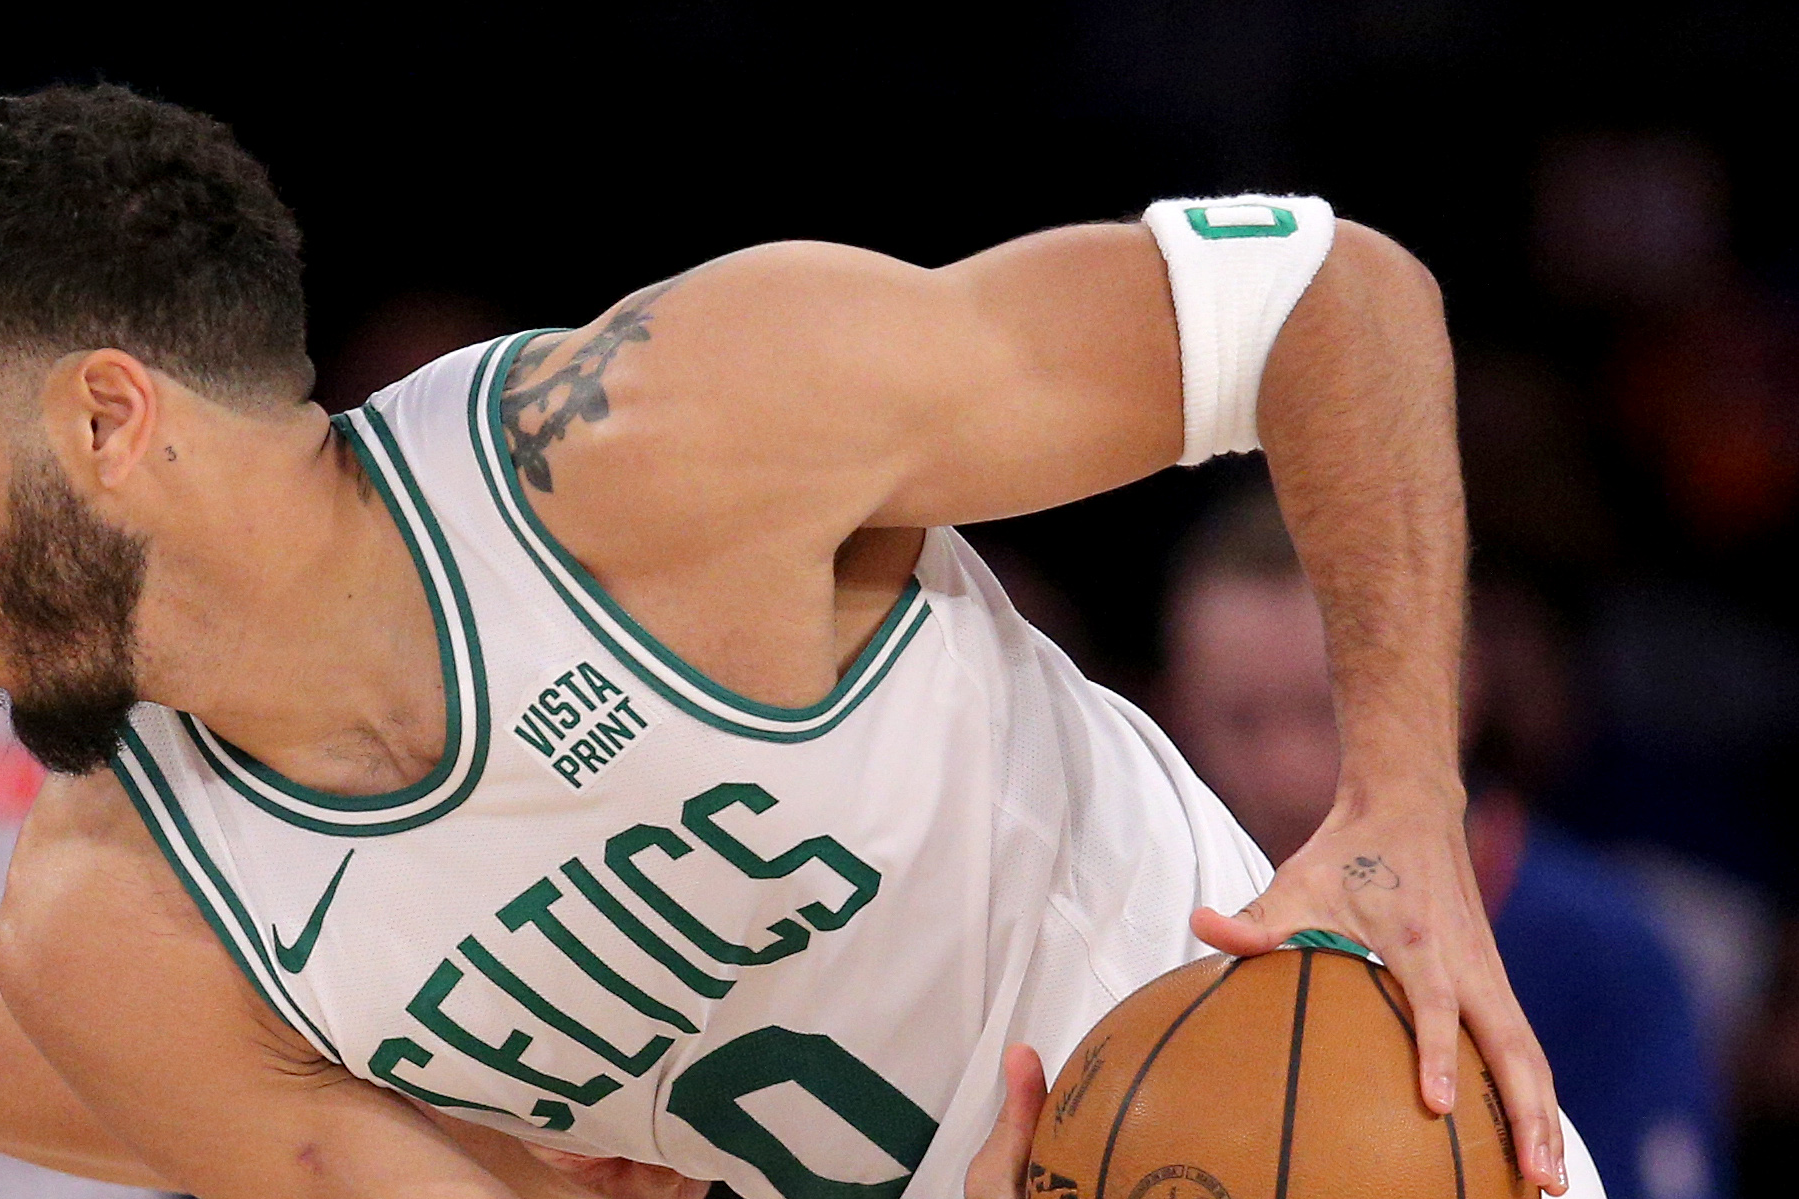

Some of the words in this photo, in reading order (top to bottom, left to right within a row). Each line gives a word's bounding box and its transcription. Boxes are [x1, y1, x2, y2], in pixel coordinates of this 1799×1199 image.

[513, 660, 623, 758] VISTA
[552, 696, 648, 789] PRINT
[367, 782, 882, 1132] CELTICS
